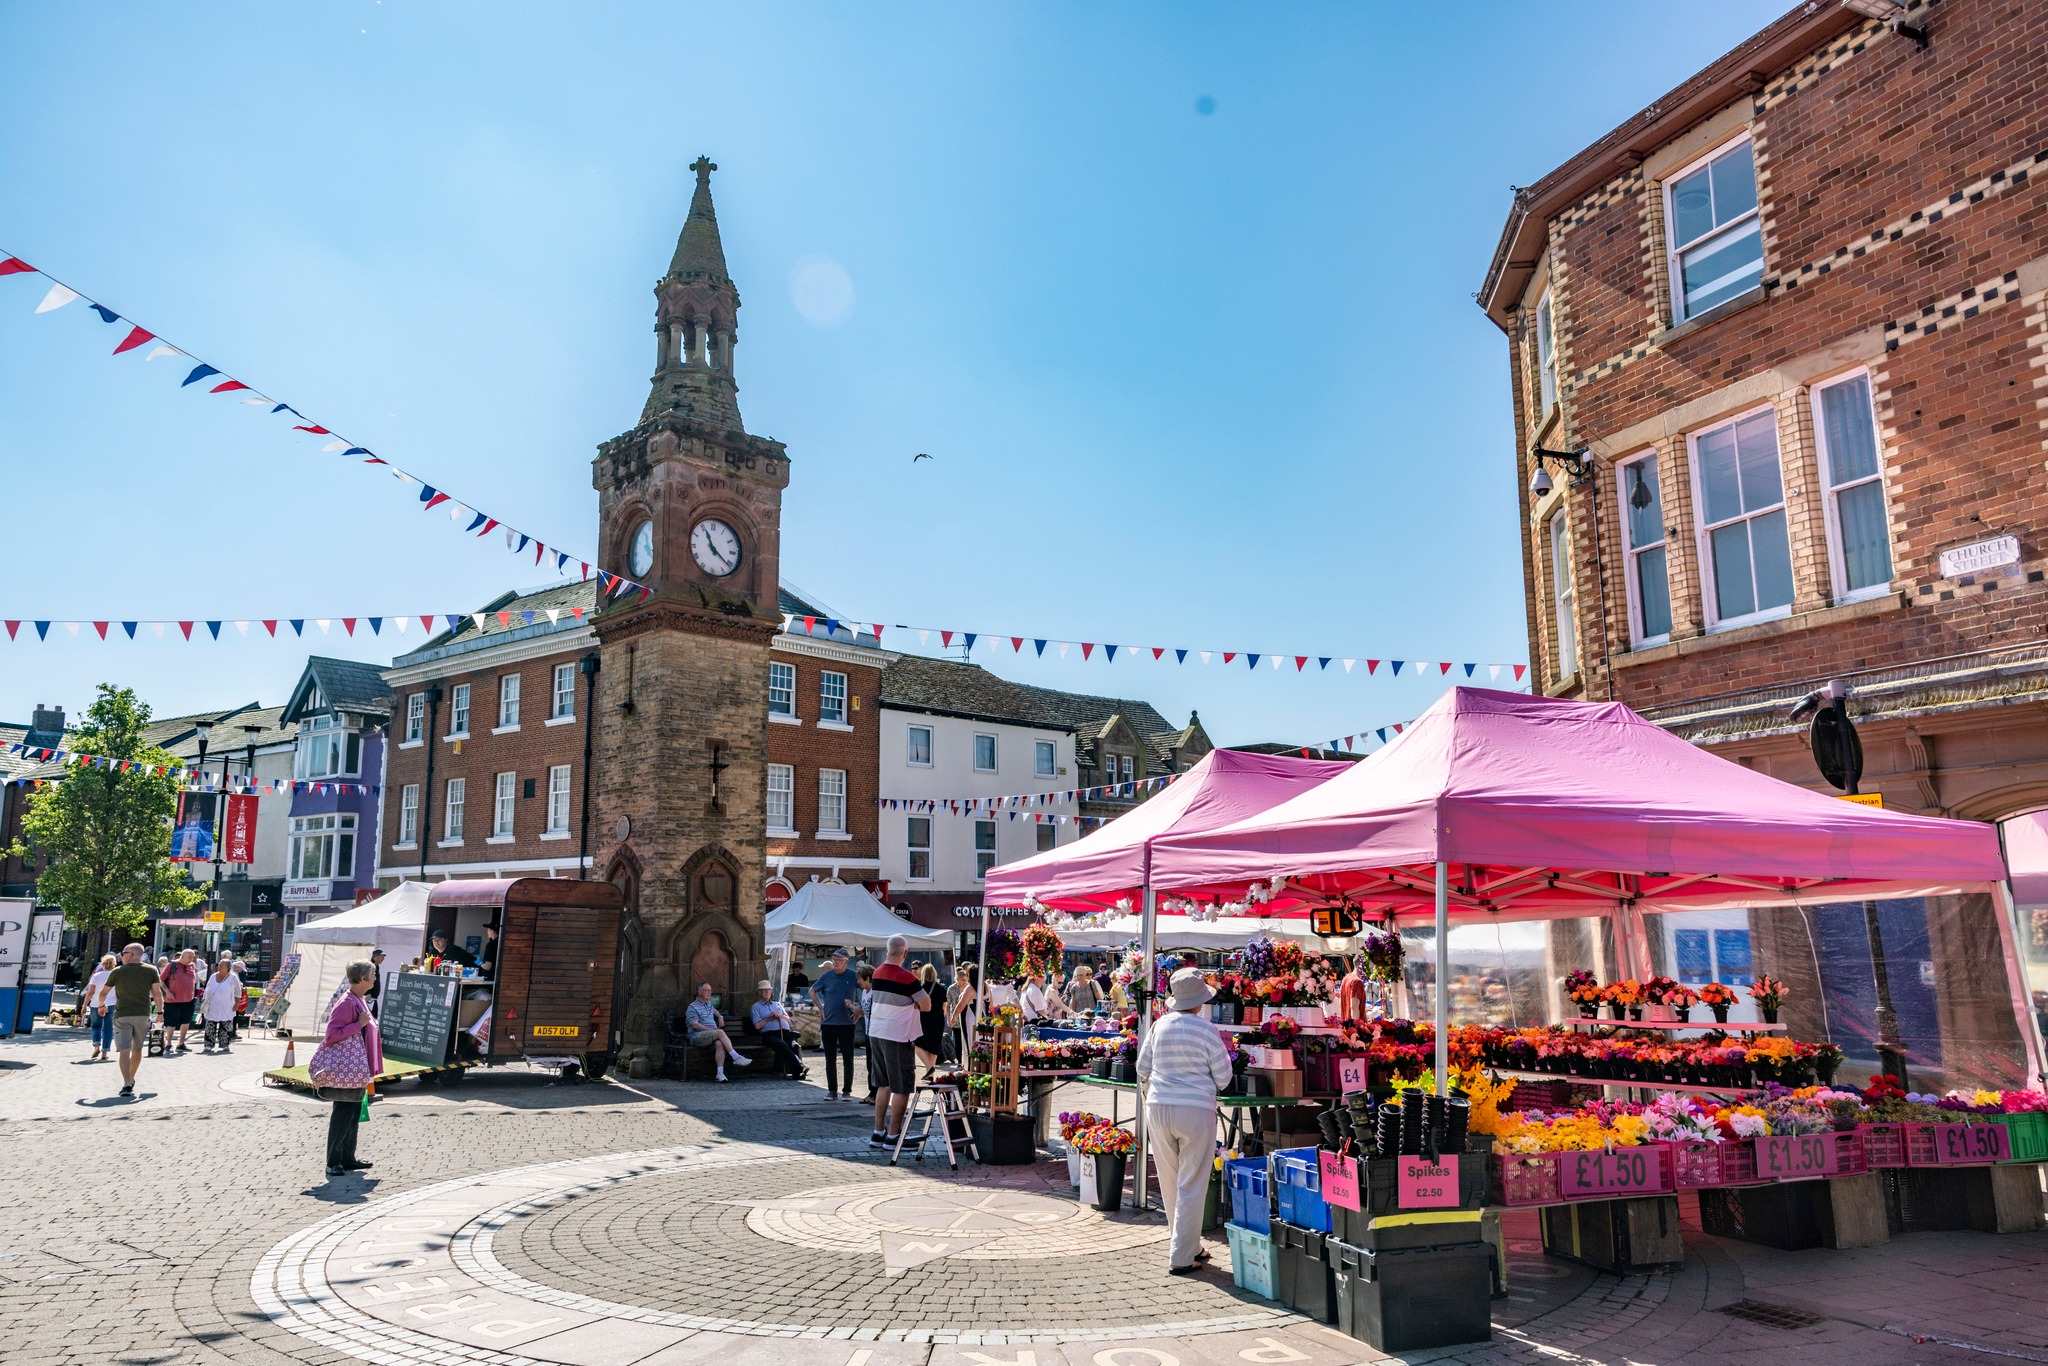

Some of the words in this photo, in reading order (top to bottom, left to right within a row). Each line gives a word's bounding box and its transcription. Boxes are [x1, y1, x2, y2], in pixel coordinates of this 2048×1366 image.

[1948, 539, 2008, 562] CHURCH
[1953, 551, 2006, 573] STREET
[290, 887, 305, 895] HAPPY
[306, 886, 320, 894] NAILS
[990, 906, 1030, 916] COFFEE
[537, 1027, 558, 1035] AD57
[559, 1027, 575, 1035] OLH
[1344, 1068, 1360, 1083] £4
[1947, 1128, 2000, 1158] £1.50
[1768, 1138, 1825, 1172] £1.50
[1083, 1161, 1093, 1178] £2
[1326, 1163, 1353, 1180] Spikes
[1408, 1166, 1450, 1179] Spikes
[1576, 1153, 1646, 1188] £1.50
[1332, 1186, 1350, 1199] £2.50
[1416, 1188, 1443, 1198] £2.50
